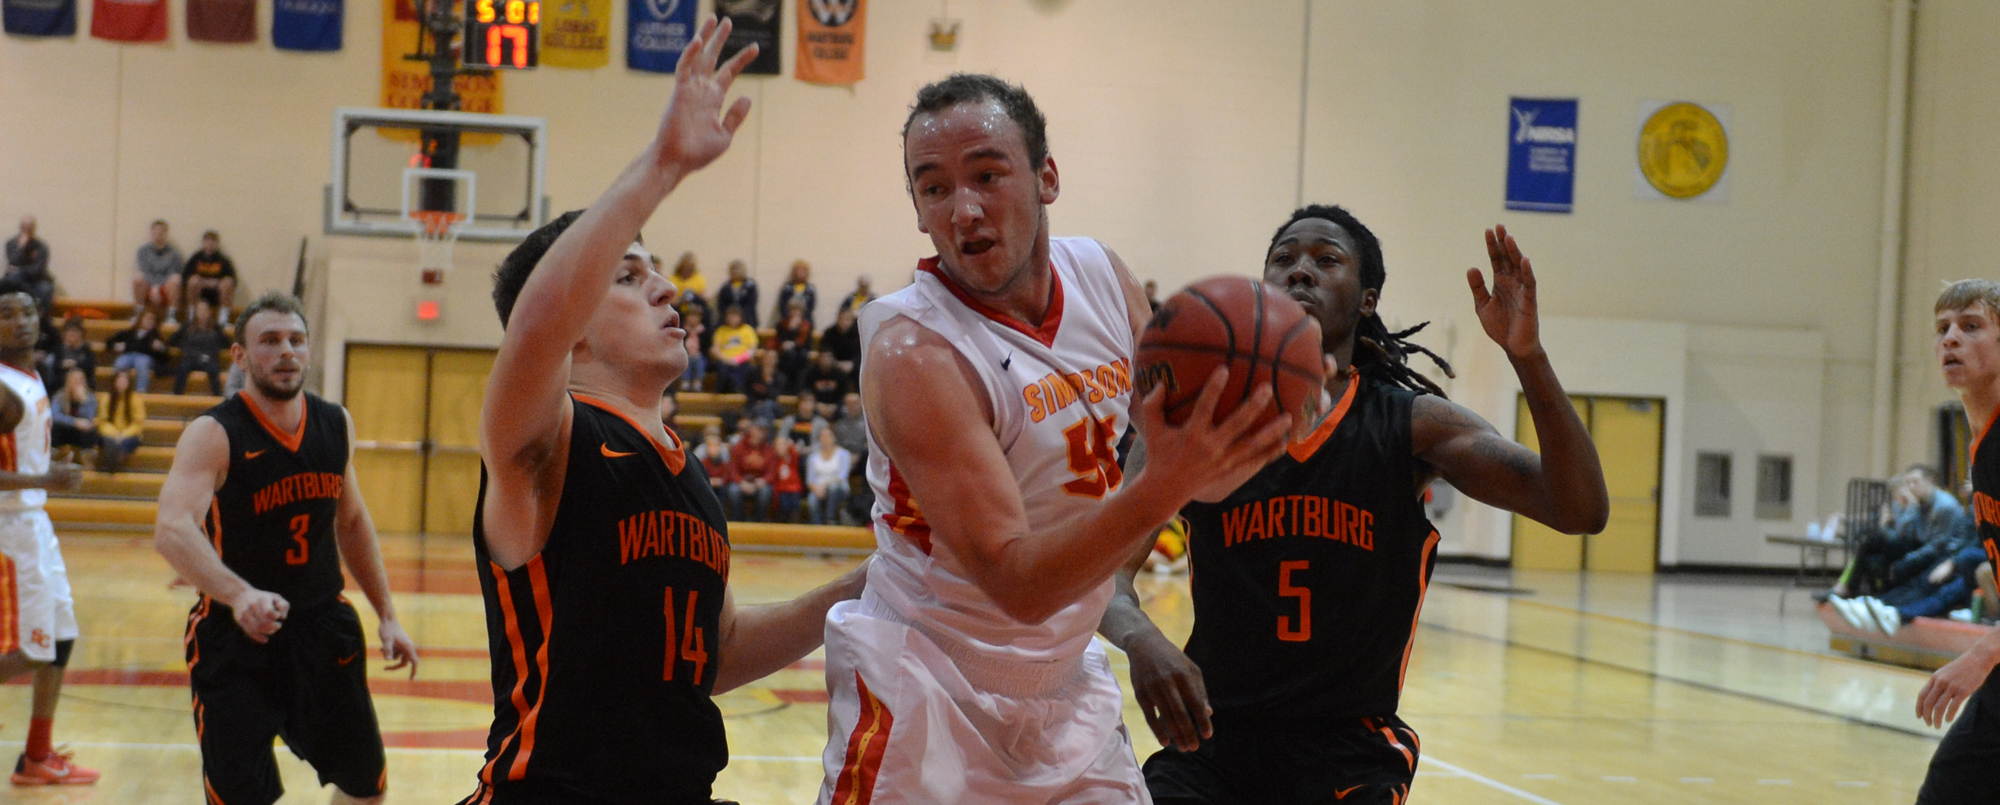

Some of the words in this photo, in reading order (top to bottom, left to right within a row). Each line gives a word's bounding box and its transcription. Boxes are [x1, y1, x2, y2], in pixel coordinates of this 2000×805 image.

[486, 25, 529, 68] 17
[285, 513, 310, 565] 3
[1221, 494, 1375, 551] WARTBURG
[1277, 560, 1311, 642] 5
[662, 586, 708, 685] 14
